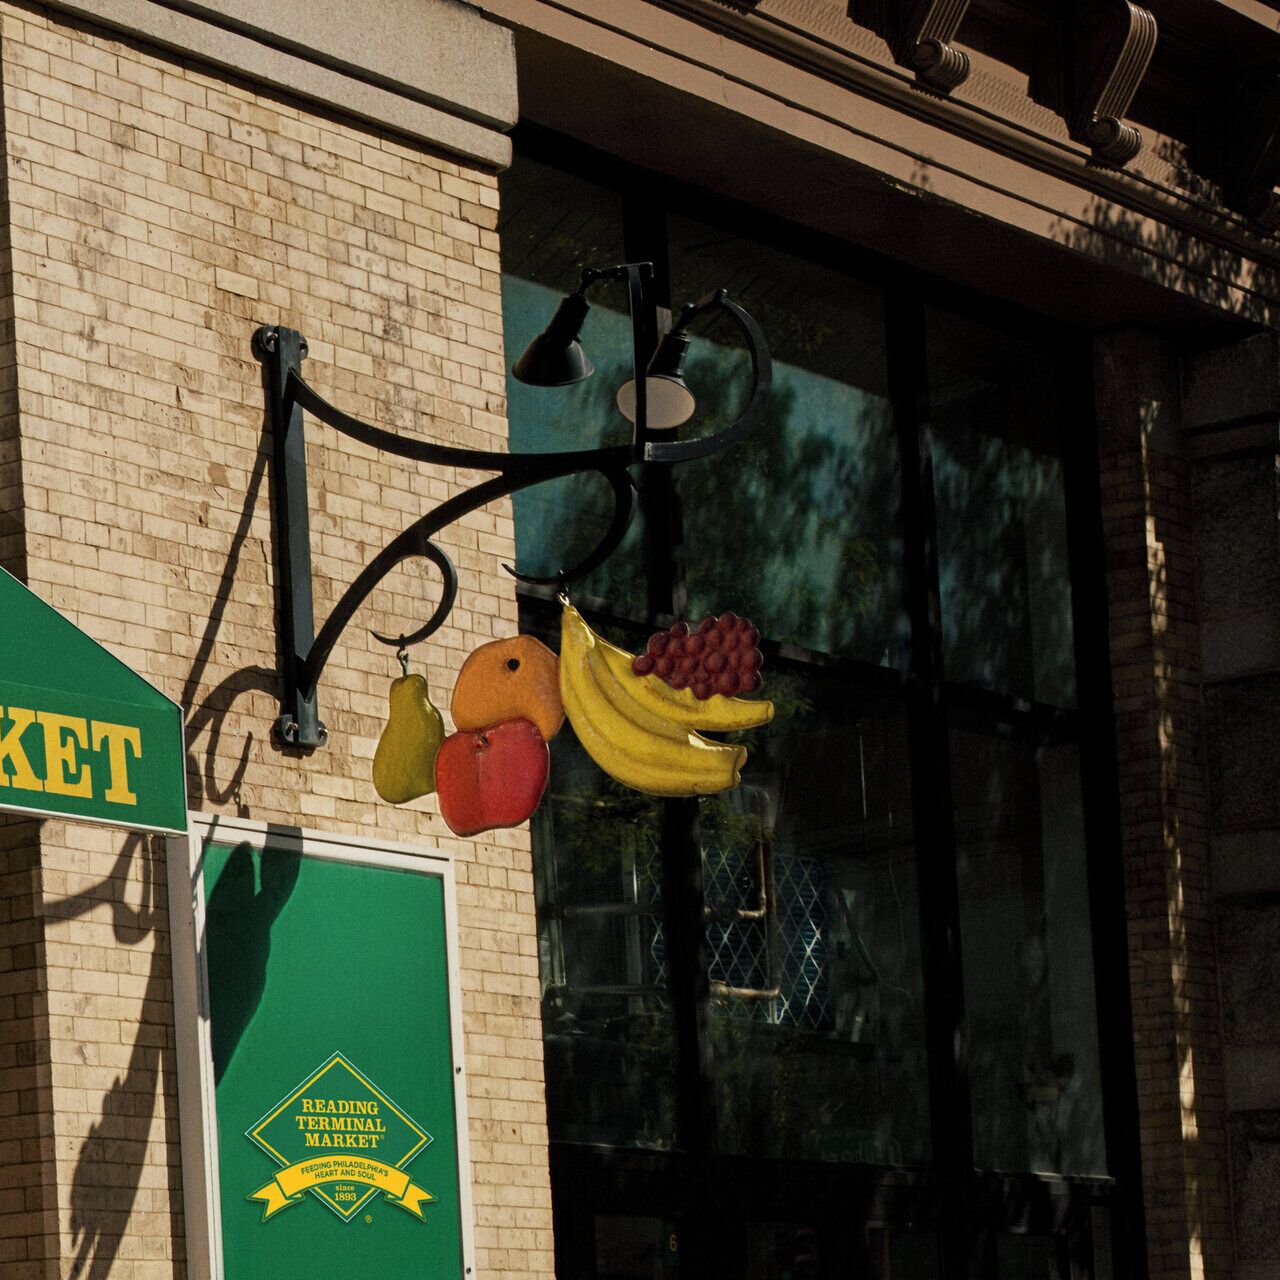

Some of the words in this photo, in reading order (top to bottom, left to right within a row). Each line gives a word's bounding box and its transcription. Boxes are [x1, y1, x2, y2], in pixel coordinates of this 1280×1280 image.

[302, 1099, 379, 1115] READING
[295, 1115, 386, 1132] TERMINAL
[305, 1133, 379, 1148] MARKET
[301, 1162, 332, 1175] FEEDING
[333, 1160, 389, 1177] PHILADELPHIA'S
[315, 1170, 338, 1179] HEART
[340, 1169, 356, 1177] AND
[357, 1170, 377, 1181] SOUL
[334, 1192, 357, 1201] 1893
